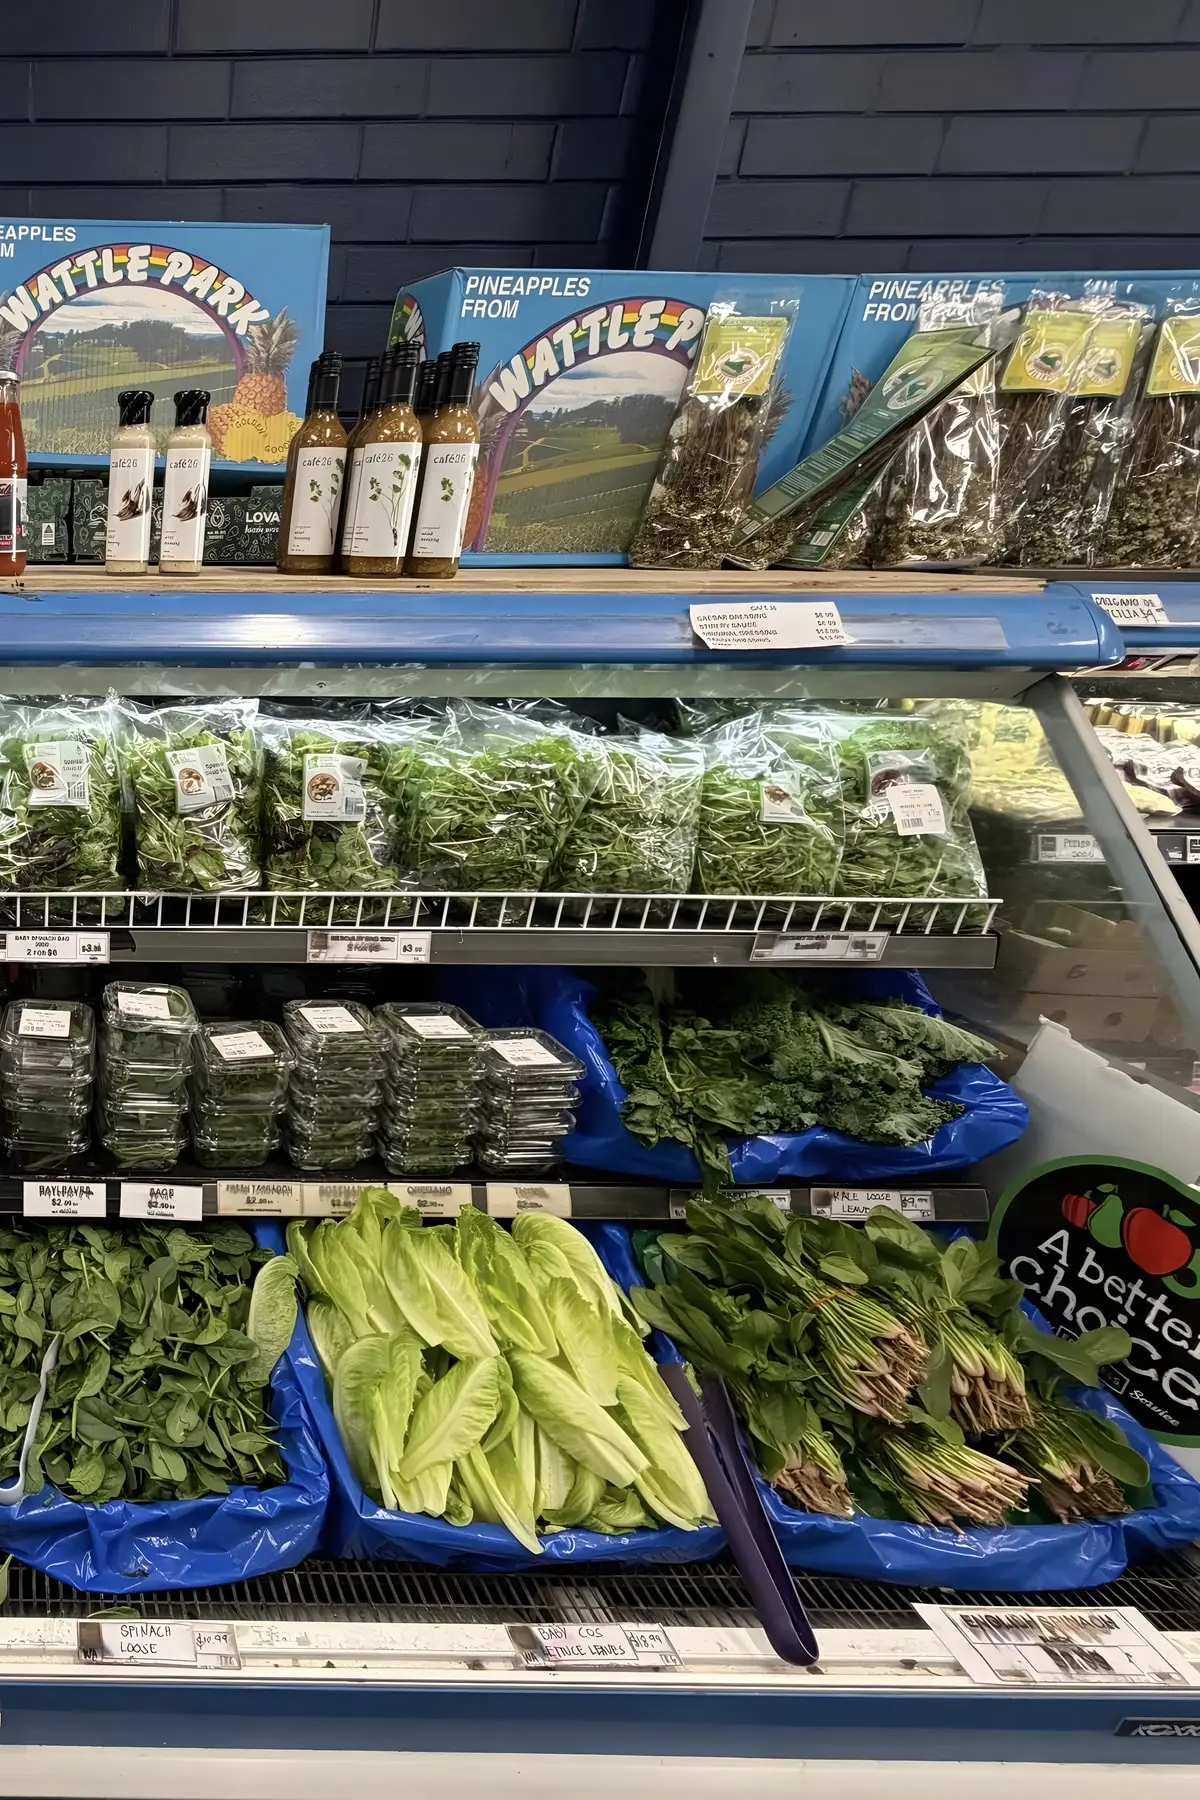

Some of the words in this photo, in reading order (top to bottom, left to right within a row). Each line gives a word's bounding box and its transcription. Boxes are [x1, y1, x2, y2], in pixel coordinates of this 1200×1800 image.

[0, 245, 151, 332] WATTLE
[160, 251, 270, 335] PARK
[465, 276, 591, 297] PINEAPPLES
[869, 279, 1004, 301] PINEAPPLES
[461, 299, 520, 319] FROM
[863, 303, 924, 322] FROM
[490, 300, 666, 413] WATTLE
[833, 1192, 858, 1201] KALE
[866, 1193, 891, 1201] LOOSE
[1037, 1229, 1069, 1267] A
[1010, 1256, 1200, 1411] Choce
[120, 1624, 171, 1638] SPINACH
[537, 1626, 567, 1640] BABY
[578, 1627, 603, 1638] COS
[120, 1641, 158, 1653] LOOSE
